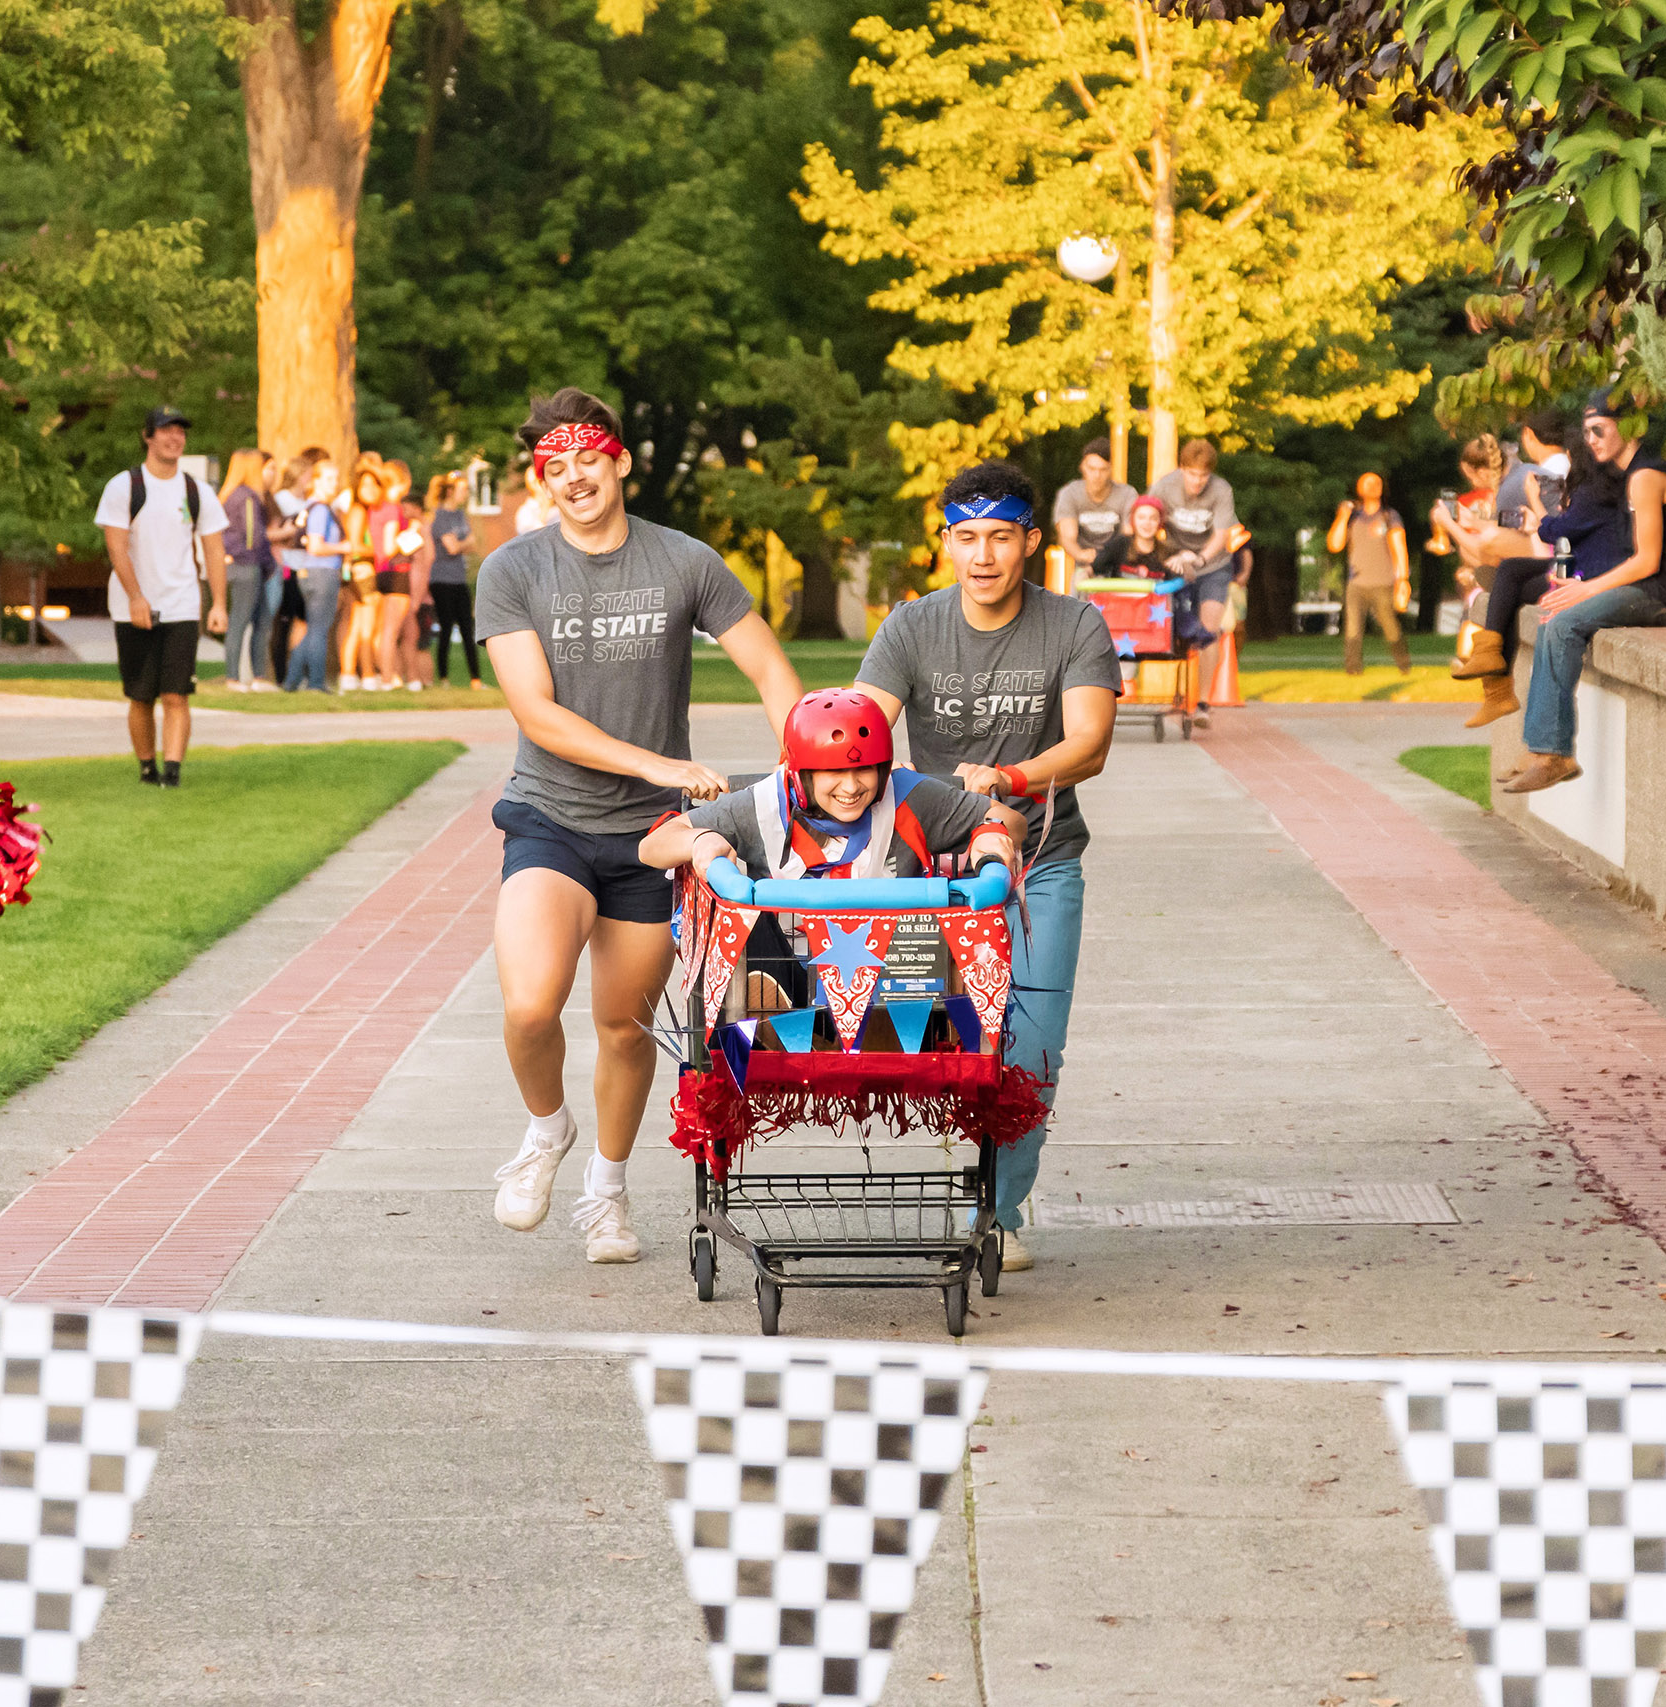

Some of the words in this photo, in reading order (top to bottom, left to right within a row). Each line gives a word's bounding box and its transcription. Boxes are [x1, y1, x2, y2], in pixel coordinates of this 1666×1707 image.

[551, 593, 584, 614] LC
[589, 587, 666, 613] STATE
[552, 618, 584, 639] LC
[591, 612, 668, 638] STATE
[554, 642, 586, 663] LC
[592, 636, 668, 662] STATE
[932, 672, 965, 695] LC
[971, 670, 1046, 694] STATE
[934, 696, 964, 717] LC
[972, 694, 1047, 716] STATE
[935, 716, 966, 737] LC
[973, 715, 1046, 737] STATE
[897, 924, 913, 933] OR
[918, 914, 933, 923] TO
